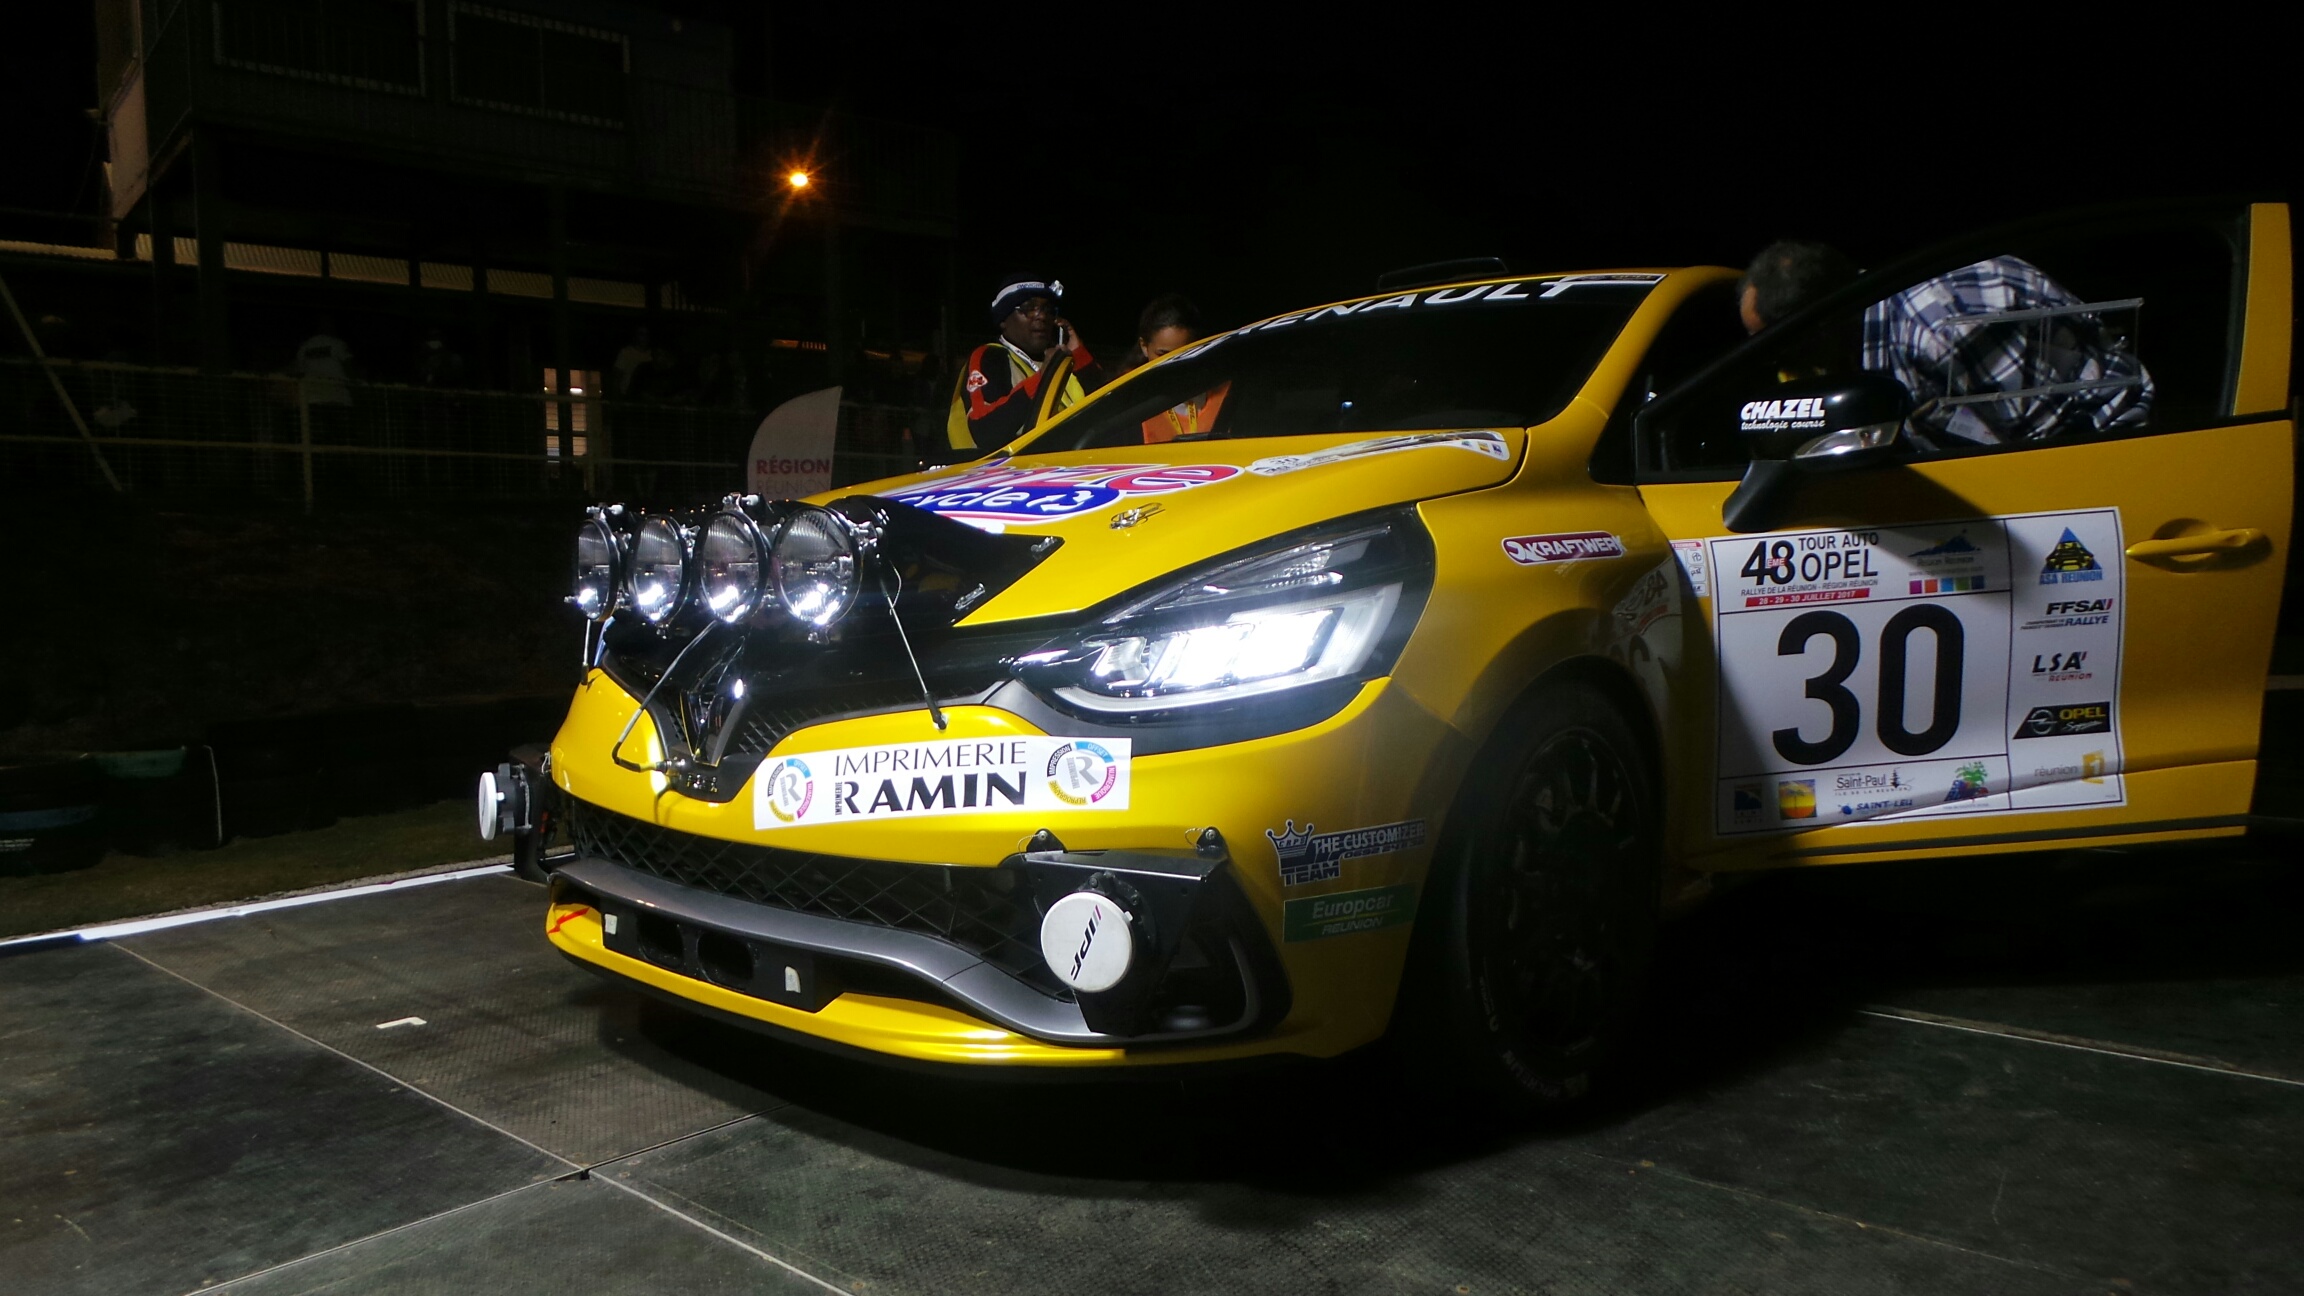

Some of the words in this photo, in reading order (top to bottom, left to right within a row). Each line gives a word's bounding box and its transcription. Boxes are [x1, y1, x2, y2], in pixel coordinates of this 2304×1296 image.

[1740, 397, 1826, 420] CHAZEL
[1790, 419, 1826, 429] course
[756, 455, 831, 475] RÉGION
[1524, 535, 1628, 559] KRAFTWERK
[1798, 535, 1836, 551] TOUR
[1842, 532, 1879, 547] AUTO
[1741, 540, 1796, 586] 48
[1767, 558, 1786, 567] EME
[1801, 549, 1878, 582] OPEL
[1741, 588, 1766, 596] RALLYE
[1767, 587, 1776, 595] DE
[1777, 586, 1786, 594] LA
[1759, 596, 1768, 605] 28
[1775, 595, 1784, 604] 29
[1801, 592, 1836, 602] JUILLET
[1837, 590, 1856, 599] 2017
[2046, 599, 2107, 615] FFSA
[2064, 615, 2110, 626] RALLYE
[1772, 603, 1965, 765] 30
[2059, 706, 2107, 720] OPEL
[835, 741, 1027, 777] IMPRIMERIE
[1087, 742, 1107, 757] OFFSET
[1047, 744, 1072, 776] IMPRESSION
[2034, 765, 2079, 777] réunion
[1836, 774, 1887, 789] Saint-Paul
[835, 781, 843, 815] IMPRIMERIE
[843, 771, 1027, 814] RAMIN
[1312, 838, 1341, 854] THE
[1343, 821, 1425, 851] CUSTOMIZER
[1280, 860, 1341, 887] TEAM
[1312, 893, 1395, 919] Europcar
[1321, 916, 1385, 935] REUNION
